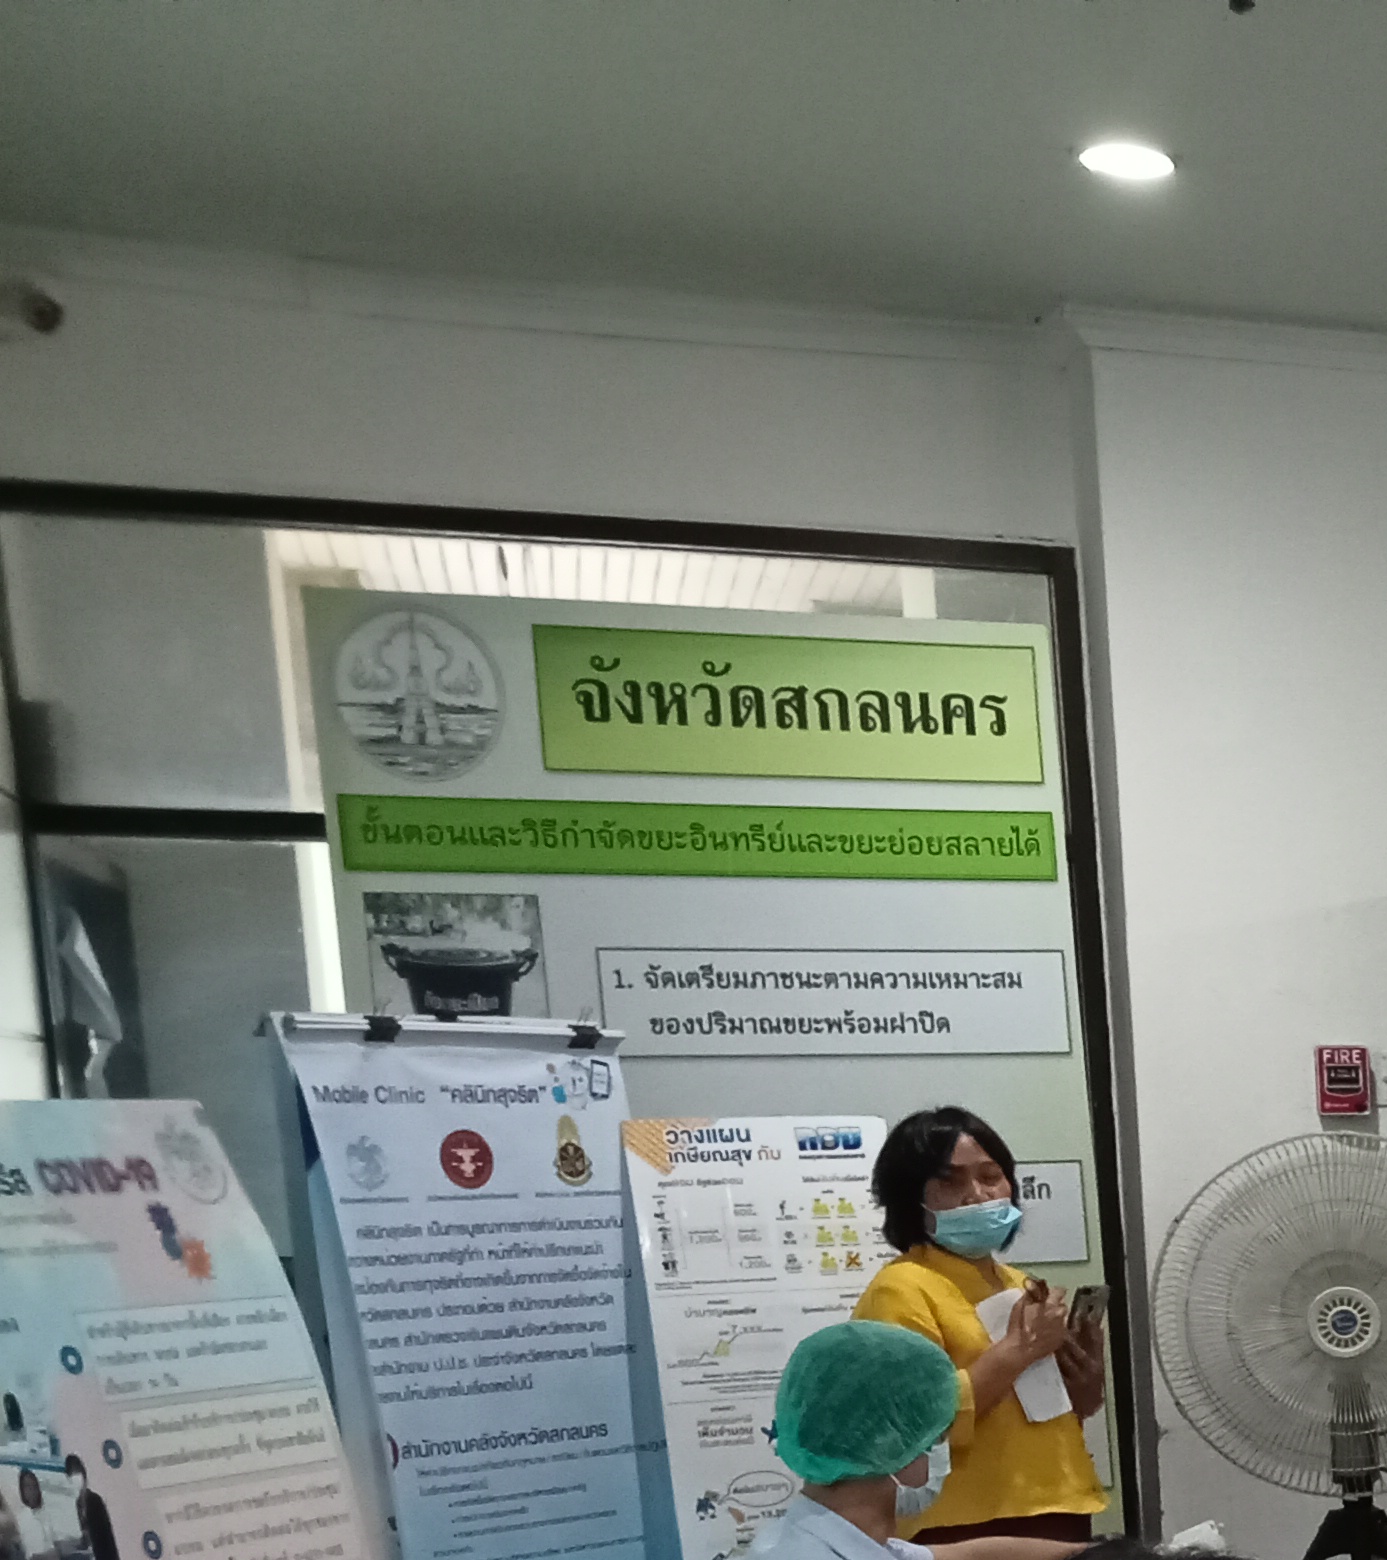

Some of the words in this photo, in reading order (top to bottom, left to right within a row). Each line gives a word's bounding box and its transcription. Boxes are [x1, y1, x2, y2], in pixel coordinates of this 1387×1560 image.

[571, 654, 1008, 739] จังหวัดสกลนคร
[360, 803, 1042, 860] ขั้นตอนและวิธีกำจัดขยะอินทรีย์และขยะย่อยสลายได้
[613, 966, 635, 991] 1.
[642, 961, 1023, 995] จัดเตรียมภาชนะตามความเหมาะสม
[649, 1006, 952, 1038] ของปริมาณขยะพร้อมฝาปิด
[1322, 1048, 1363, 1064] FIRE
[311, 1083, 369, 1104] Mobile
[374, 1083, 426, 1104] Clinic
[664, 1126, 752, 1146] วางแผน
[401, 1421, 610, 1461] สำนักงานคลังจังหวัดสกลนคร
